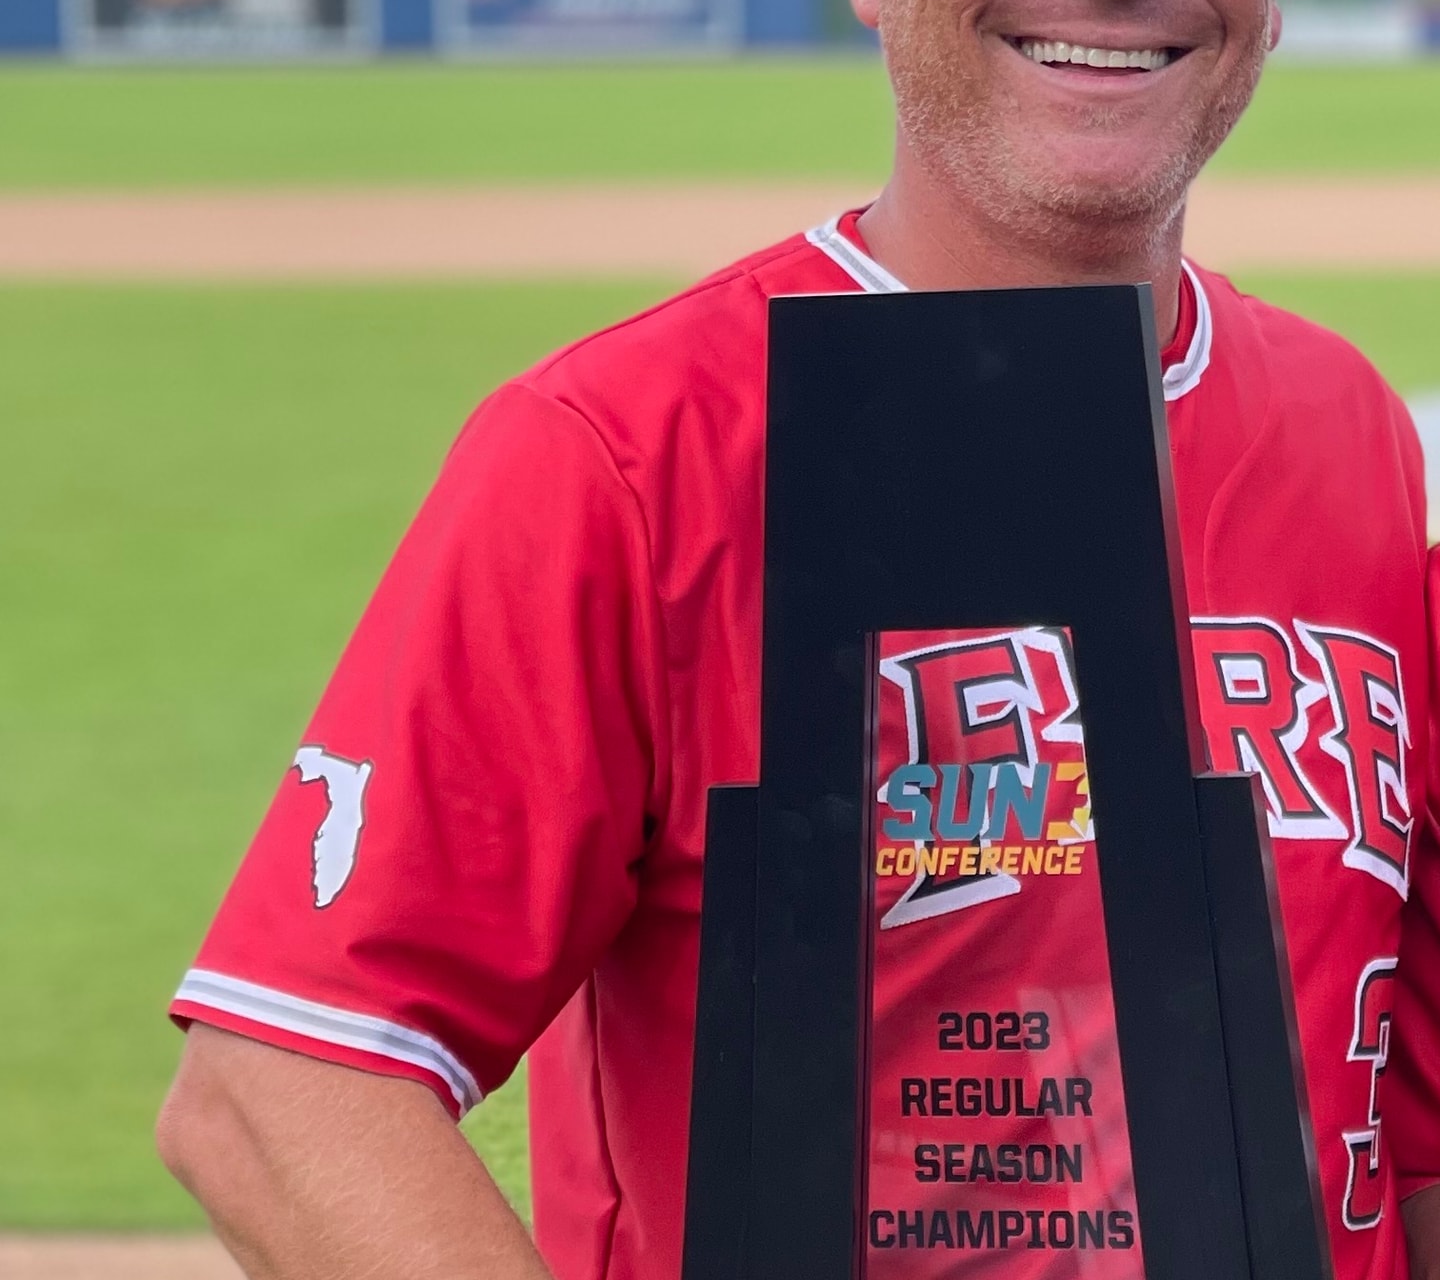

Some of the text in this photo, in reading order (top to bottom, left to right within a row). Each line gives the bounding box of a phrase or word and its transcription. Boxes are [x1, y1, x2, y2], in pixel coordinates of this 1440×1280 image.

[882, 762, 1053, 842] SUN
[875, 845, 1086, 877] CONFERENCE
[937, 1011, 1051, 1051] 2023
[901, 1077, 1093, 1117] REGULAR
[913, 1143, 1083, 1184] SEASON
[868, 1209, 1135, 1250] CHAMPIONS
